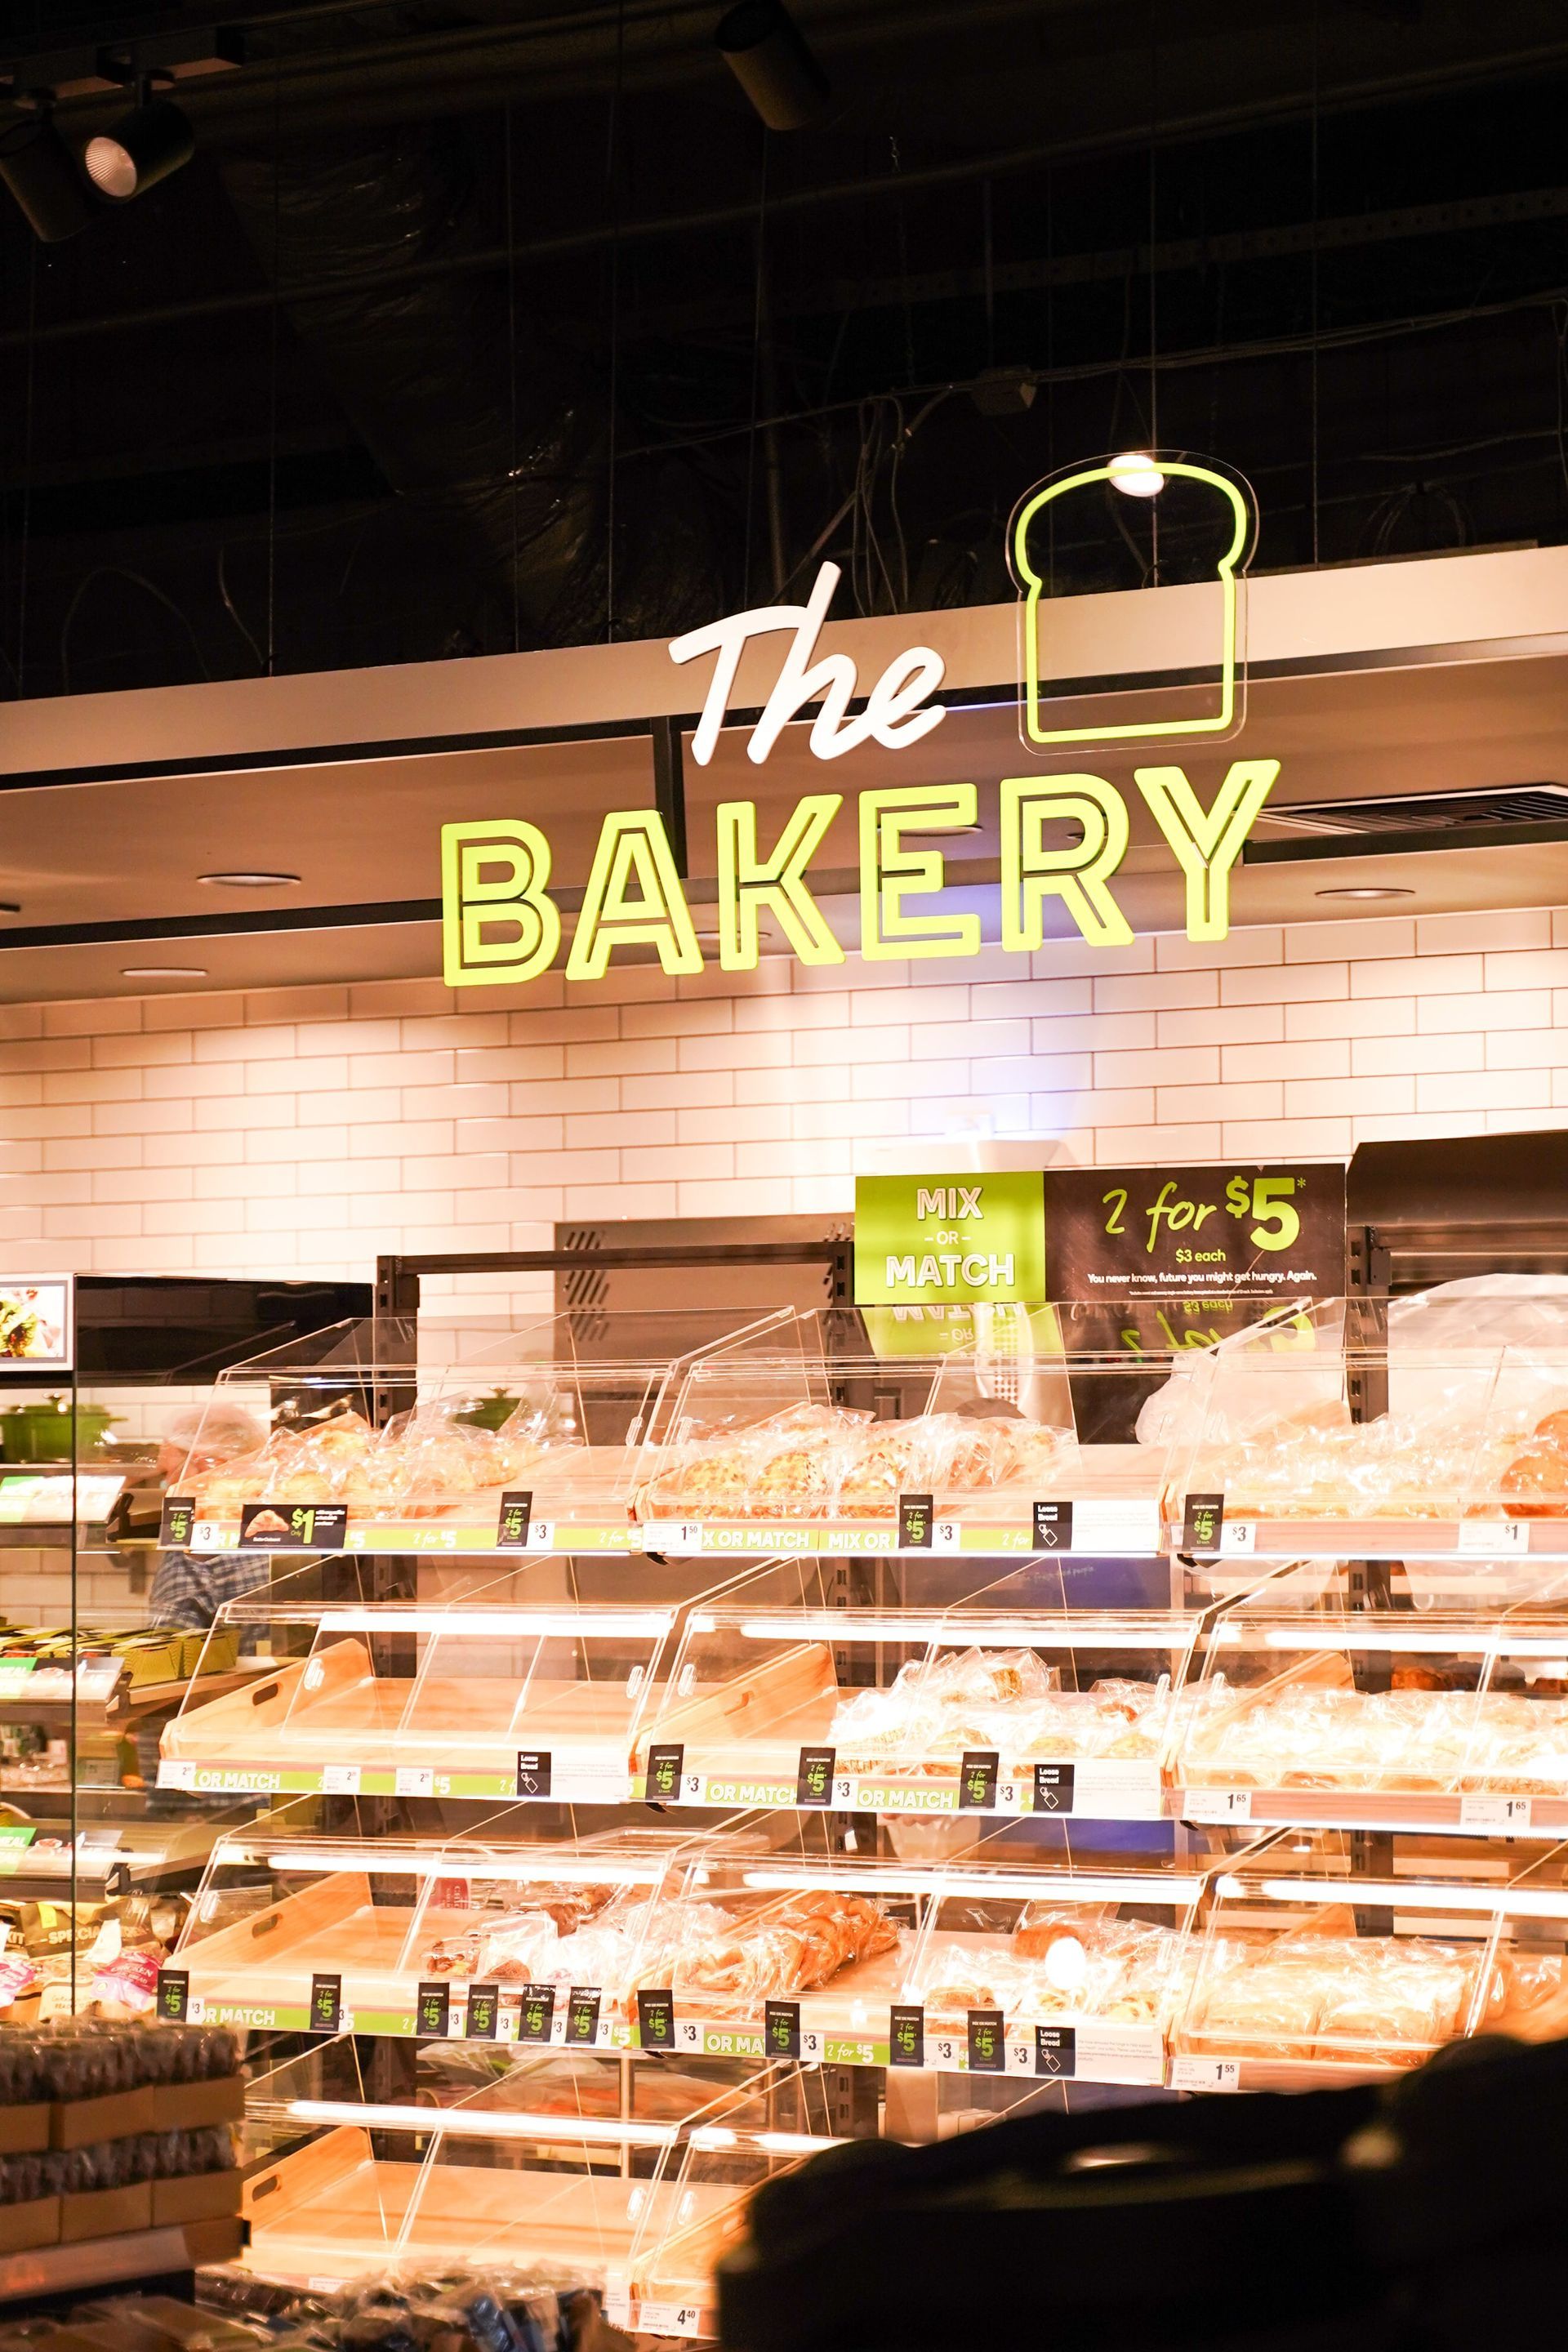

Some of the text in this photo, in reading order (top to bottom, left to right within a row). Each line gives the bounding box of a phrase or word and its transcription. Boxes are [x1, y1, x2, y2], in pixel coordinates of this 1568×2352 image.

[668, 559, 947, 766] The
[441, 759, 1281, 987] BAKERY
[917, 1187, 983, 1220] MIX
[1102, 1188, 1127, 1235] 2
[1145, 1181, 1217, 1254] for
[1176, 1249, 1226, 1263] $3 each
[886, 1254, 1014, 1288] MATCH
[1087, 1270, 1317, 1285] You never know, future you might get hungry. Again.
[914, 1511, 924, 1521] for
[1203, 1511, 1214, 1521] for
[200, 1526, 211, 1540] $3
[292, 1508, 314, 1544] $1
[536, 1525, 547, 1539] $3
[939, 1525, 953, 1540] $3
[1232, 1526, 1246, 1542] $3
[1505, 1524, 1518, 1540] $1
[413, 1533, 421, 1544] 2
[421, 1532, 439, 1548] for
[600, 1532, 606, 1542] 2
[607, 1530, 625, 1547] for
[718, 1531, 743, 1548] OR
[746, 1531, 809, 1548] MATCH
[828, 1533, 890, 1549] MIX OR
[1001, 1531, 1030, 1549] 2 for
[664, 1762, 674, 1771] for
[816, 1764, 826, 1774] for
[1039, 1767, 1059, 1775] Loose
[198, 1771, 280, 1789] OR MATCH
[975, 1771, 986, 1780] for
[434, 1776, 450, 1794] $5
[687, 1777, 699, 1792] $3
[837, 1781, 850, 1797] $3
[710, 1784, 736, 1802] OR
[859, 1789, 953, 1808] OR MATCH
[1000, 1785, 1013, 1802] $3
[220, 2008, 275, 2026] MATCH
[450, 2013, 459, 2025] $3
[500, 2017, 509, 2029] $3
[554, 2021, 562, 2033] $3
[599, 2024, 608, 2035] $3
[684, 2025, 696, 2041] $3
[905, 2023, 915, 2033] for
[983, 2028, 992, 2038] for
[1040, 2029, 1060, 2038] Loose
[613, 2026, 630, 2046] $5
[707, 2034, 733, 2052] OR
[804, 2034, 817, 2051] $3
[1040, 2038, 1060, 2047] Bread
[827, 2043, 874, 2064] 2 for $5
[938, 2042, 951, 2059] $3
[1013, 2047, 1027, 2064] $3
